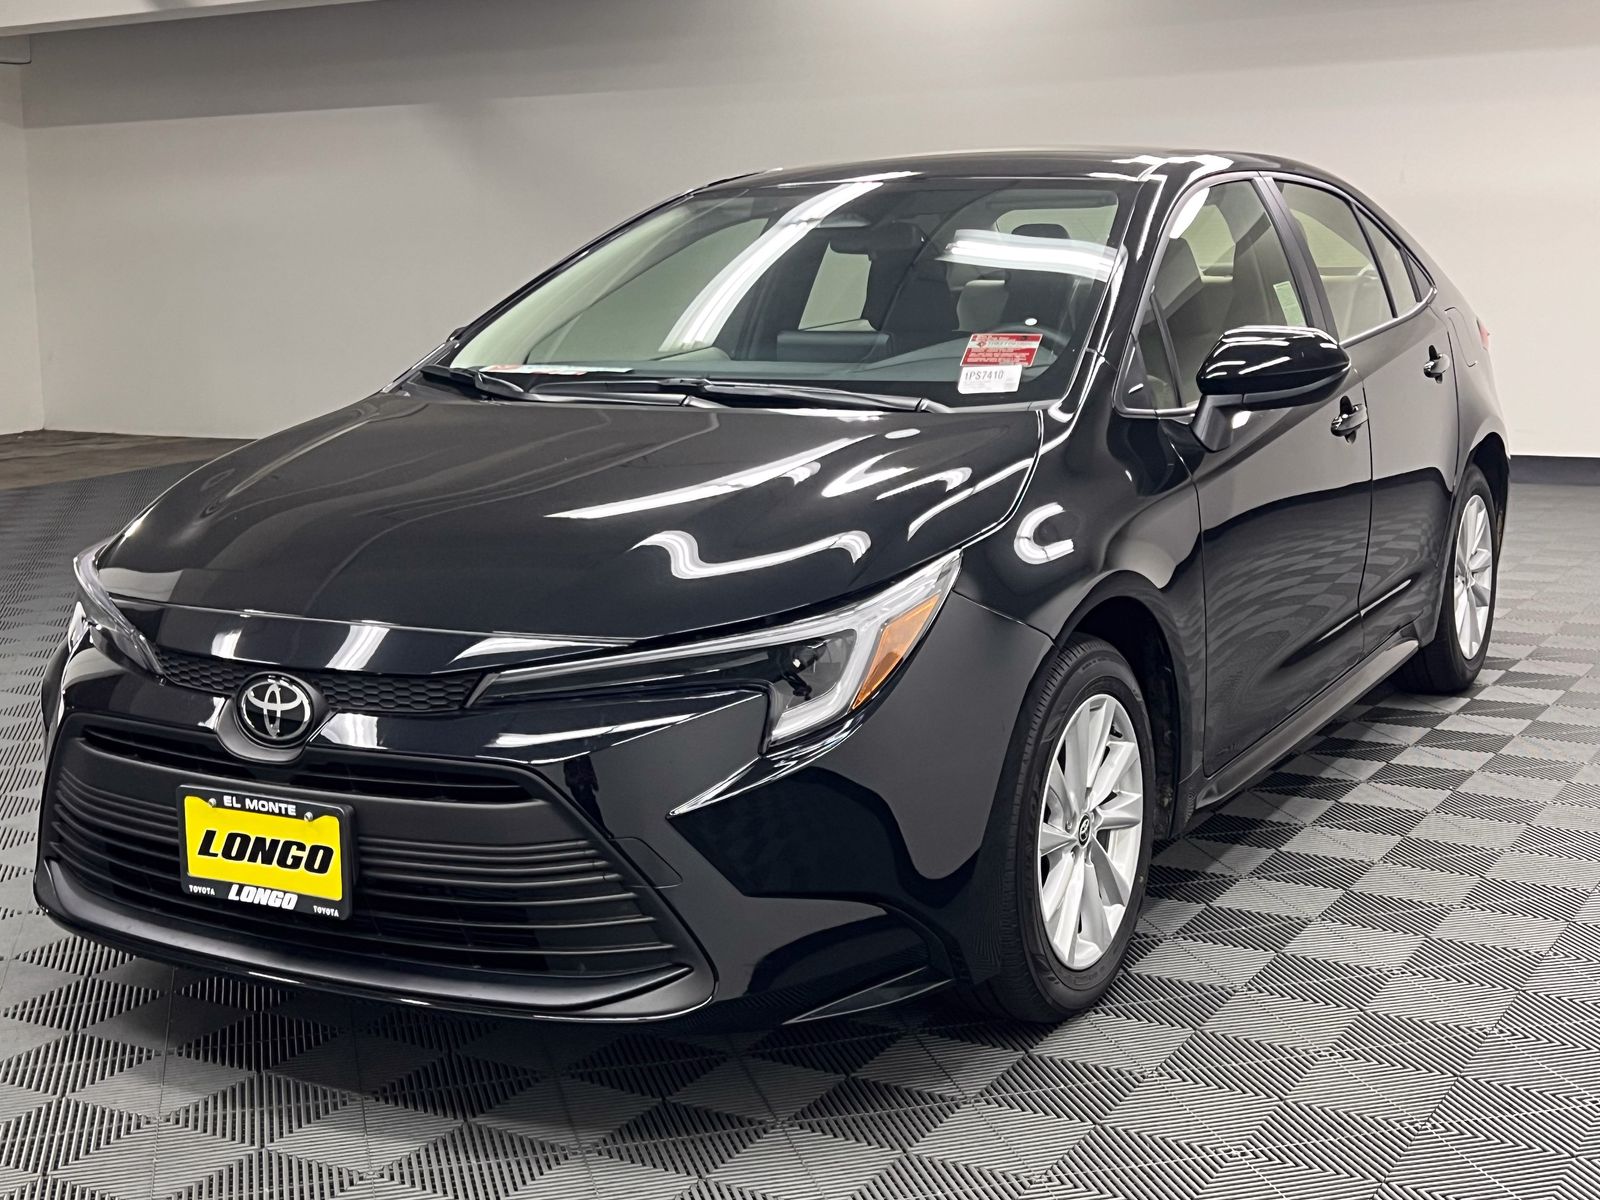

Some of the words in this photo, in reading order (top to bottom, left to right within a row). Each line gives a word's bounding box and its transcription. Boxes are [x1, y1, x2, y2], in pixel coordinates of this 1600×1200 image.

[964, 370, 1004, 381] 1PS7410
[223, 795, 241, 808] EL
[245, 799, 297, 816] MONTE
[197, 829, 334, 875] LONGO
[188, 884, 215, 896] TOYOTA
[227, 884, 298, 910] LONGO
[313, 905, 340, 918] TOYOTA
